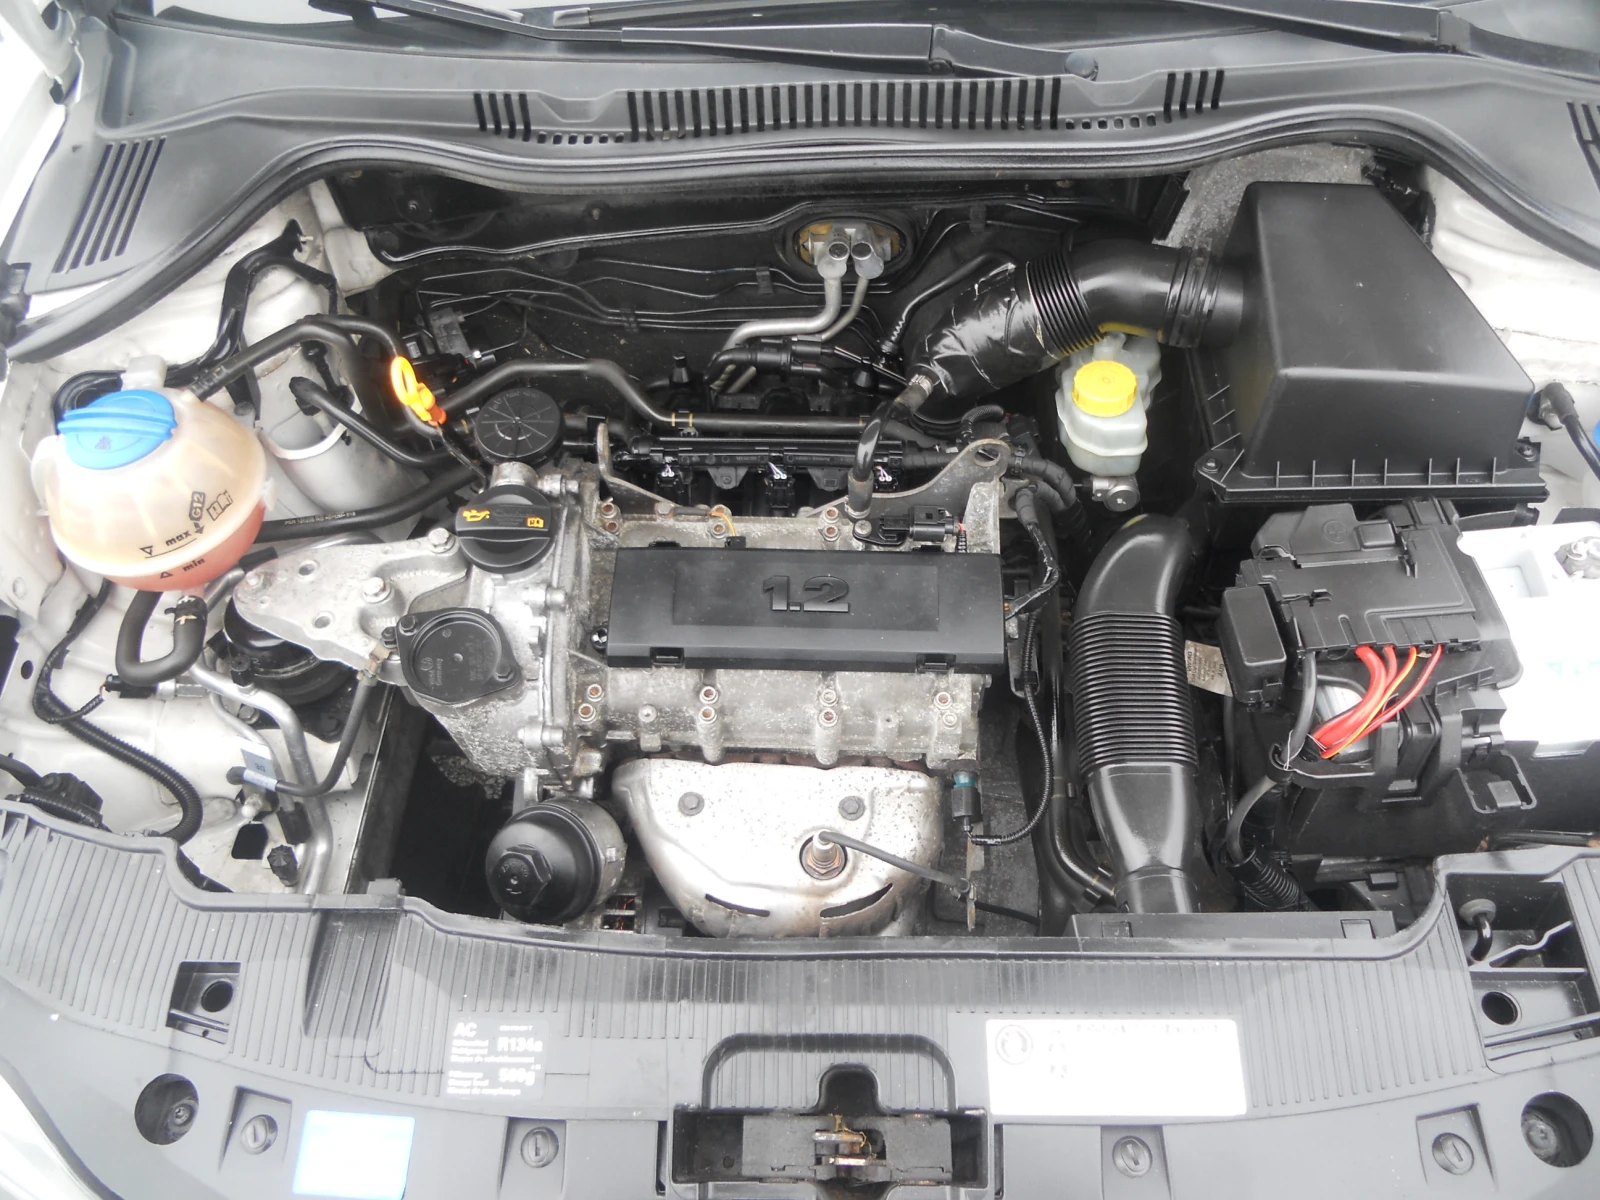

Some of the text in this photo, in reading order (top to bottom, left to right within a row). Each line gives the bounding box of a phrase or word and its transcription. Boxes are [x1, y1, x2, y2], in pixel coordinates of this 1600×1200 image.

[191, 492, 205, 518] G12
[165, 530, 193, 547] max
[182, 558, 206, 572] min
[762, 575, 850, 613] 1.2
[453, 1022, 477, 1037] AC
[497, 1036, 543, 1052] R134a
